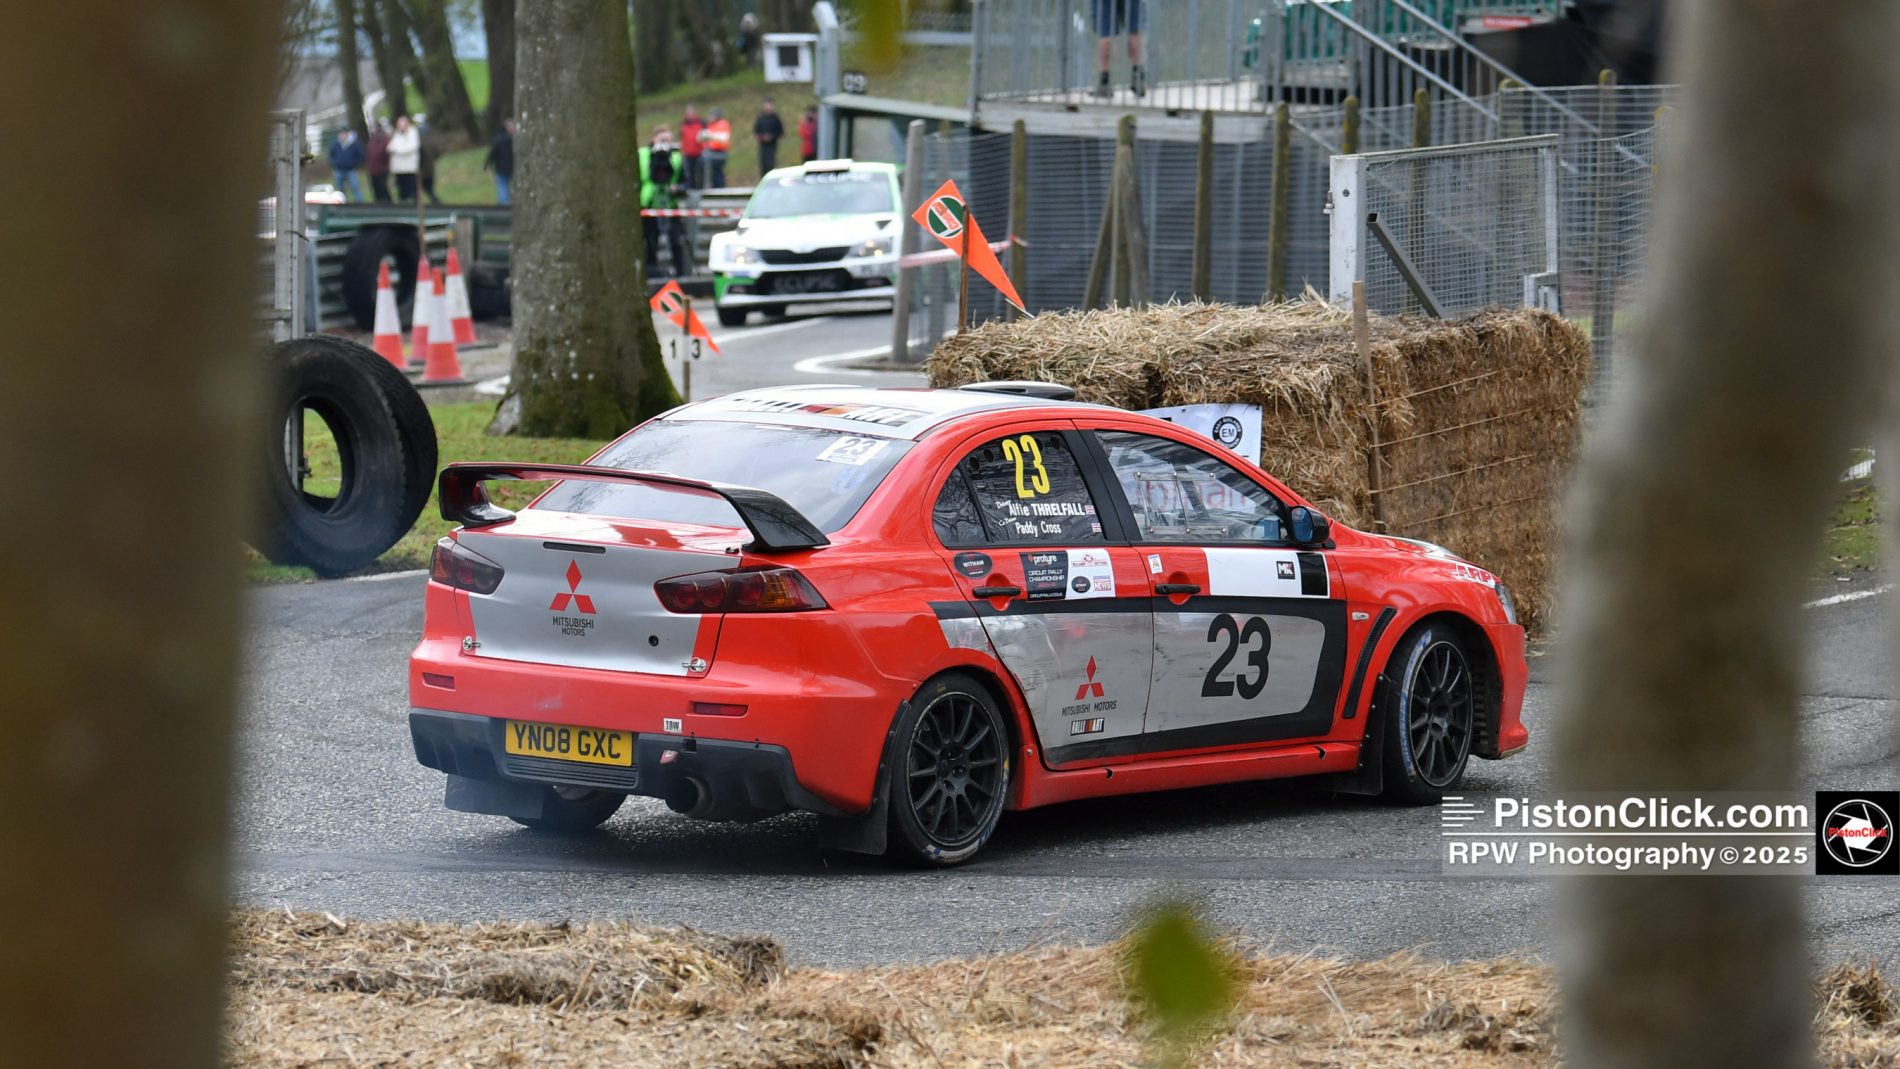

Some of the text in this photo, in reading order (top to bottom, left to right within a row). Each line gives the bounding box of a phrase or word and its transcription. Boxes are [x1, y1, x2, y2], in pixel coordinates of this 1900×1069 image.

[690, 338, 702, 360] 3
[1221, 428, 1235, 439] EM
[837, 437, 876, 455] 23
[1002, 434, 1050, 499] 23
[1009, 502, 1086, 516] Alfie THRELFALL
[1015, 520, 1062, 538] Paddy Cross
[1455, 564, 1492, 583] ARP
[552, 616, 594, 629] MITSUBISHI
[562, 627, 586, 637] MOTORS
[1201, 613, 1271, 700] 23
[1062, 699, 1118, 717] MITSUBISHI MOTORS
[513, 723, 622, 760] YN08 GXC
